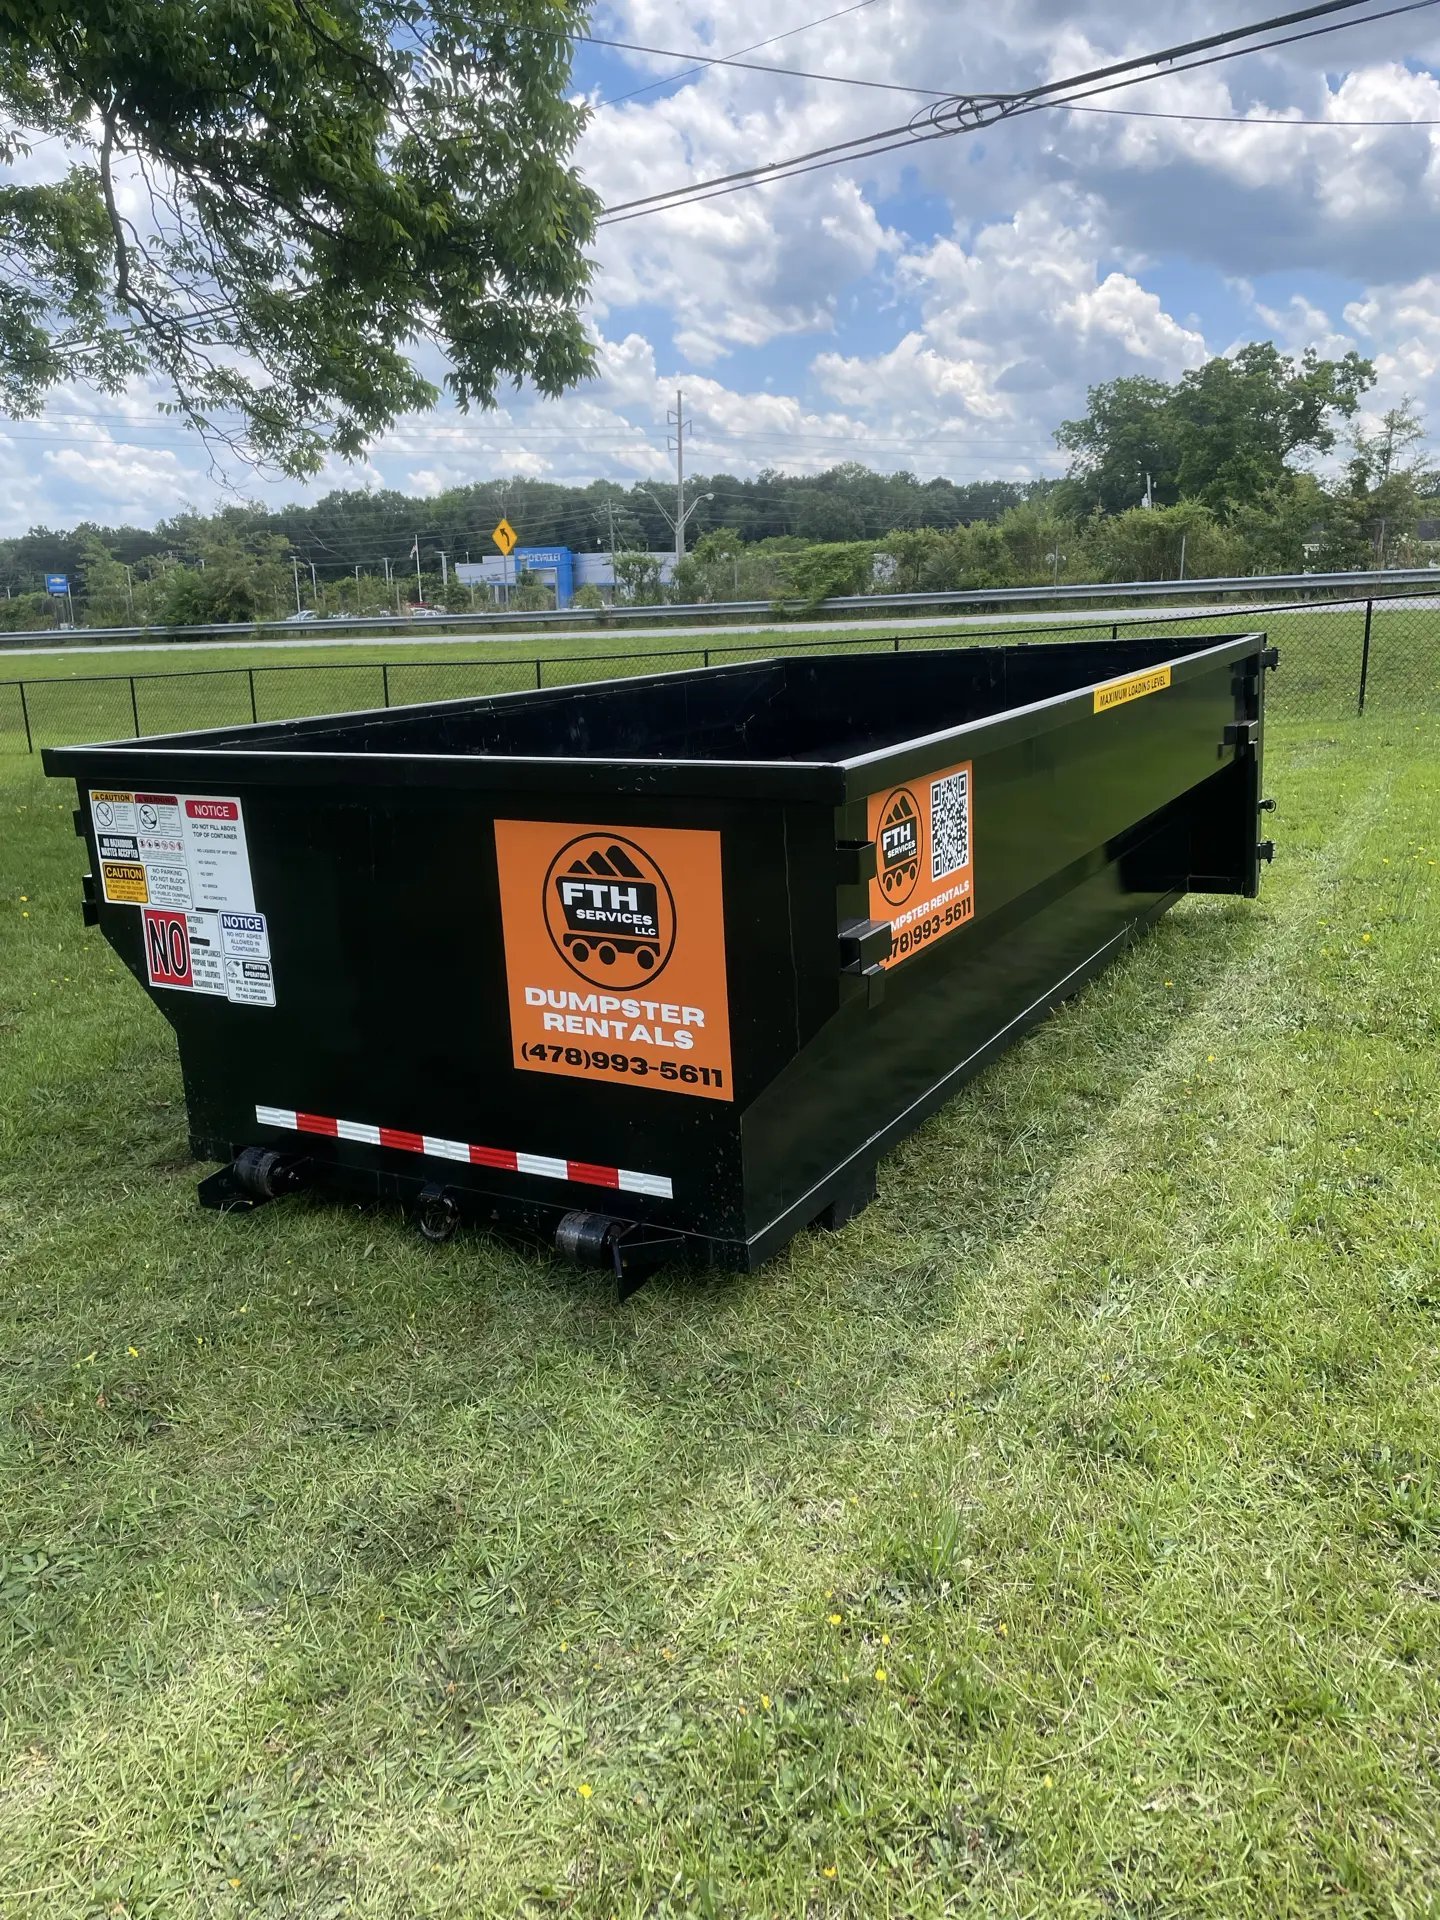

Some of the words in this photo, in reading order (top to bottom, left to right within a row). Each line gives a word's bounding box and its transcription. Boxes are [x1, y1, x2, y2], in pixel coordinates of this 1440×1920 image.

[1100, 688, 1127, 707] MAXIMUM
[1128, 680, 1150, 697] LOADING
[1151, 676, 1166, 689] LEVEL
[100, 793, 130, 802] CAUTION
[194, 804, 230, 817] NOTICE
[210, 832, 238, 840] CONTAINER
[882, 822, 911, 851] FTH
[887, 839, 916, 859] SERVICES
[908, 848, 917, 857] LLC
[106, 867, 142, 879] CAUTION
[160, 868, 182, 876] PARKING
[155, 883, 184, 892] CONTAINER
[562, 881, 638, 911] FTH
[890, 902, 930, 933] MPSTER
[930, 880, 970, 910] RENTALS
[223, 916, 262, 930] NOTICE
[576, 909, 653, 926] SERVICES
[635, 926, 656, 936] LLC
[887, 896, 971, 960] 78)993-5611
[147, 918, 187, 978] NO
[524, 987, 705, 1028] DUMPSTER
[543, 1012, 694, 1050] RENTALS
[521, 1041, 723, 1088] (478)993-5611
